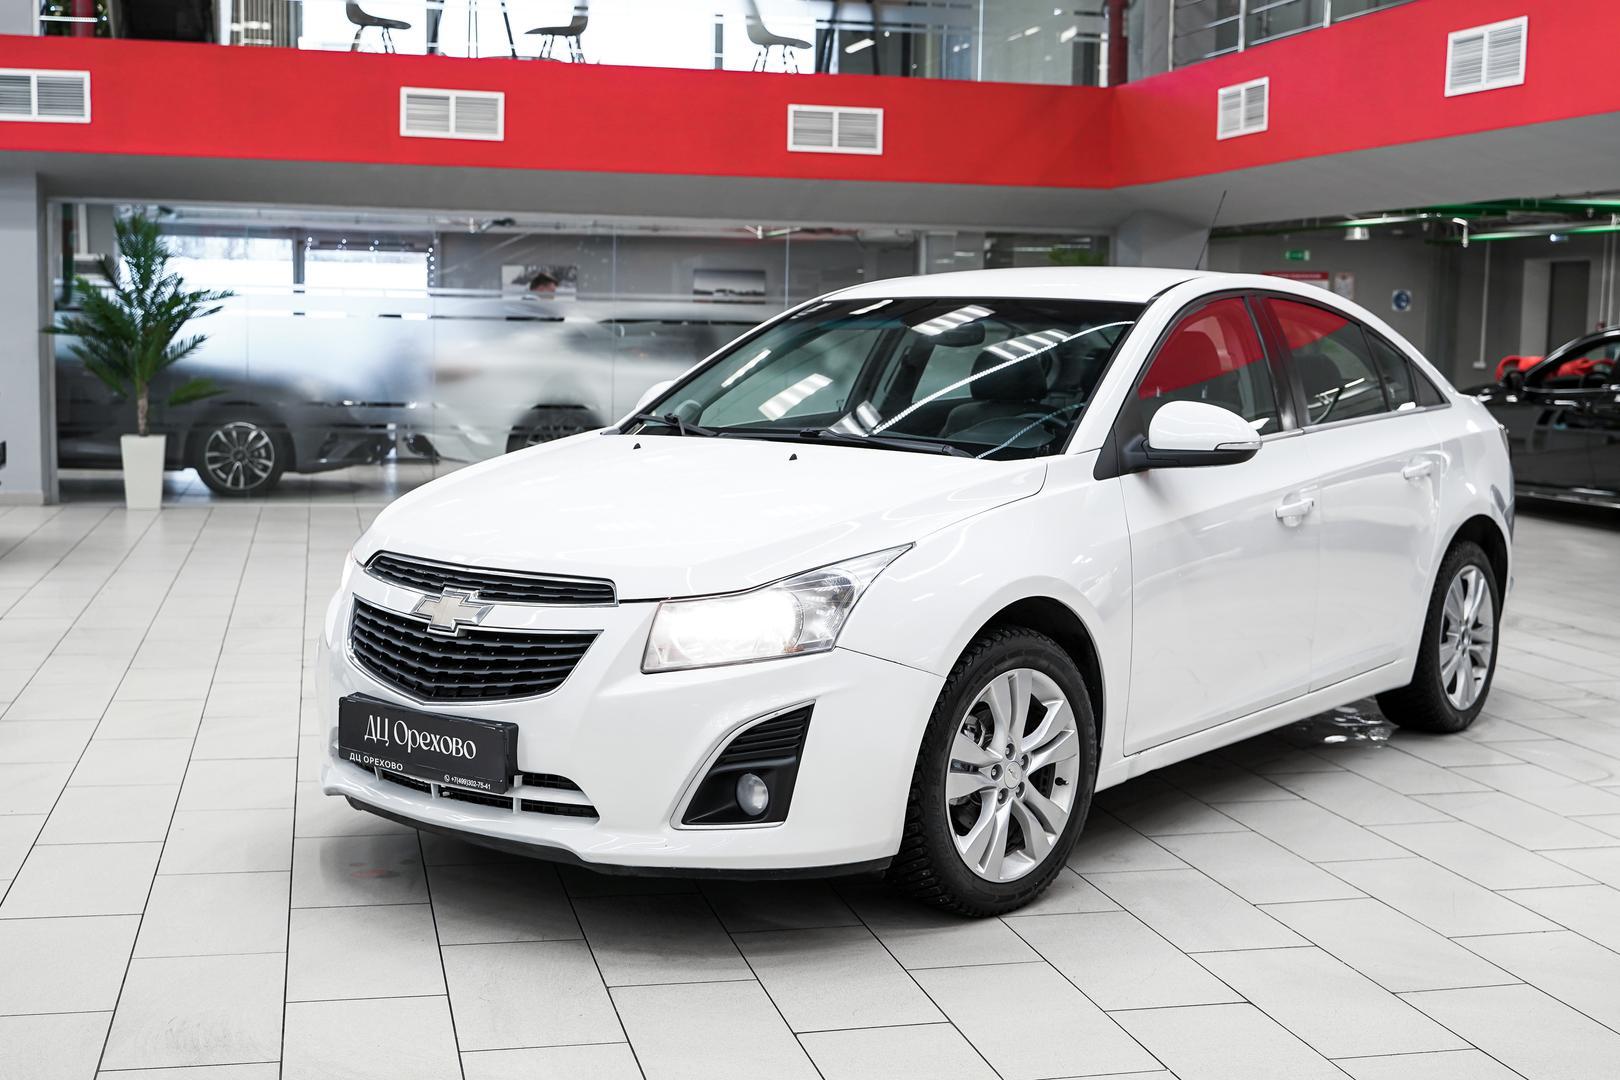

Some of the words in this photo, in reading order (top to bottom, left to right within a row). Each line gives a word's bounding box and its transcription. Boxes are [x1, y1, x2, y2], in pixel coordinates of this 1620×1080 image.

[364, 714, 389, 747] ДЦ
[393, 720, 477, 760] Орехово
[350, 752, 361, 763] ДЦ
[363, 755, 403, 771] ОРЕХОВО
